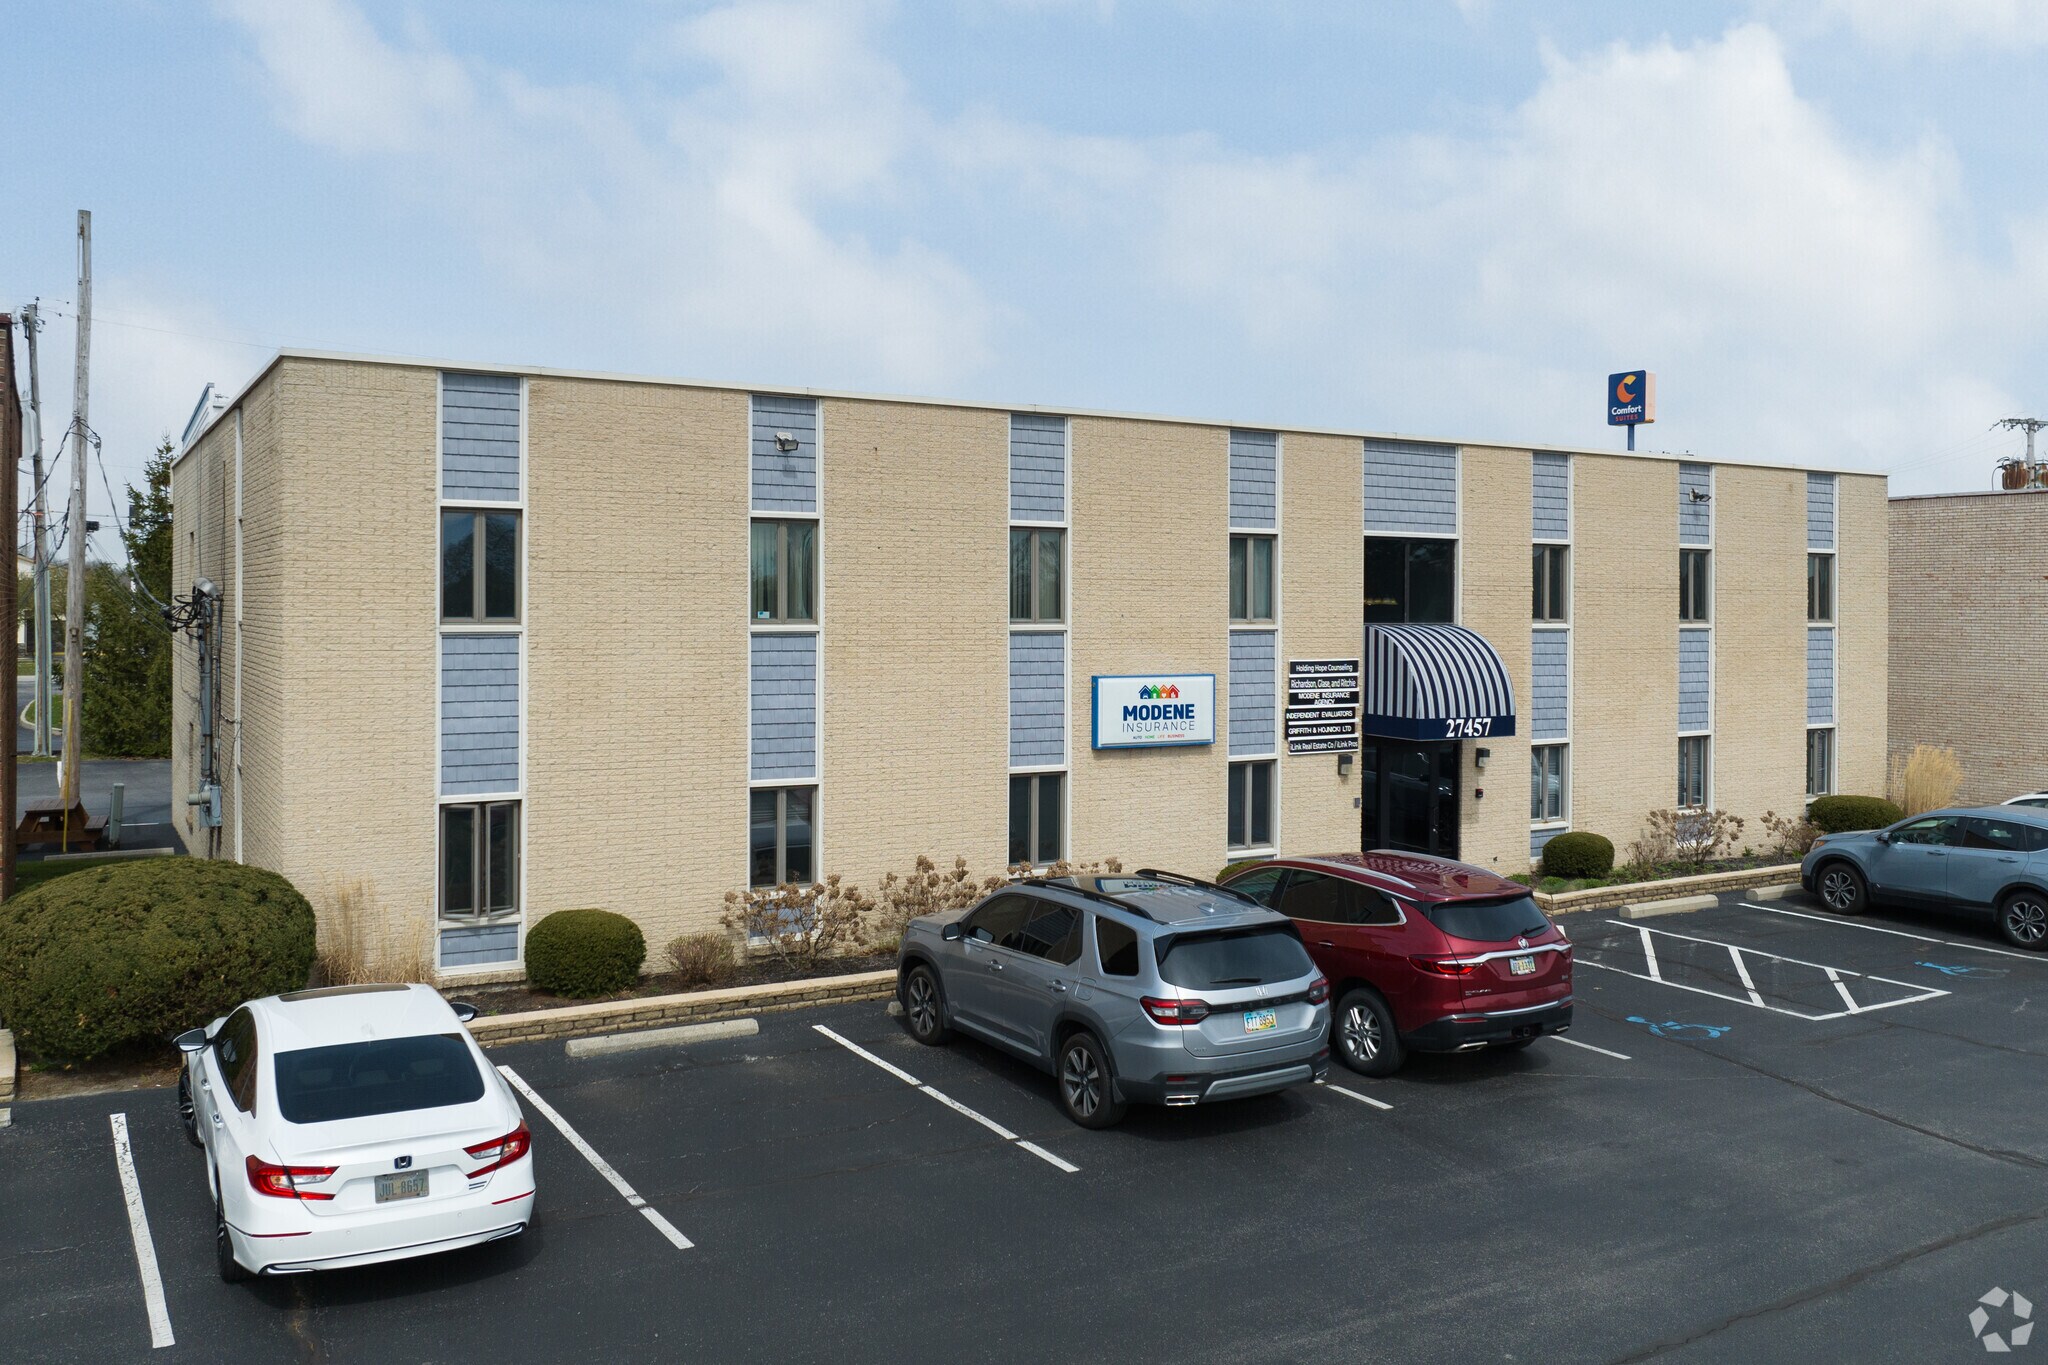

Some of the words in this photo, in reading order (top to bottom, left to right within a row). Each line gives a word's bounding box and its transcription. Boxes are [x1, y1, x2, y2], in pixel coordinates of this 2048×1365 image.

[1611, 405, 1642, 415] Comfort
[1296, 665, 1314, 673] Holding
[1328, 664, 1353, 672] Counseling
[1331, 679, 1340, 687] and
[1322, 691, 1350, 699] INSURANCE
[1123, 704, 1195, 721] MODENE
[1321, 710, 1353, 718] EVALUATORS
[1122, 721, 1195, 733] INSURANCE
[1446, 718, 1492, 737] 27457
[1313, 742, 1327, 750] Estate
[380, 1182, 397, 1197] JUL
[401, 1178, 425, 1194] 8657
